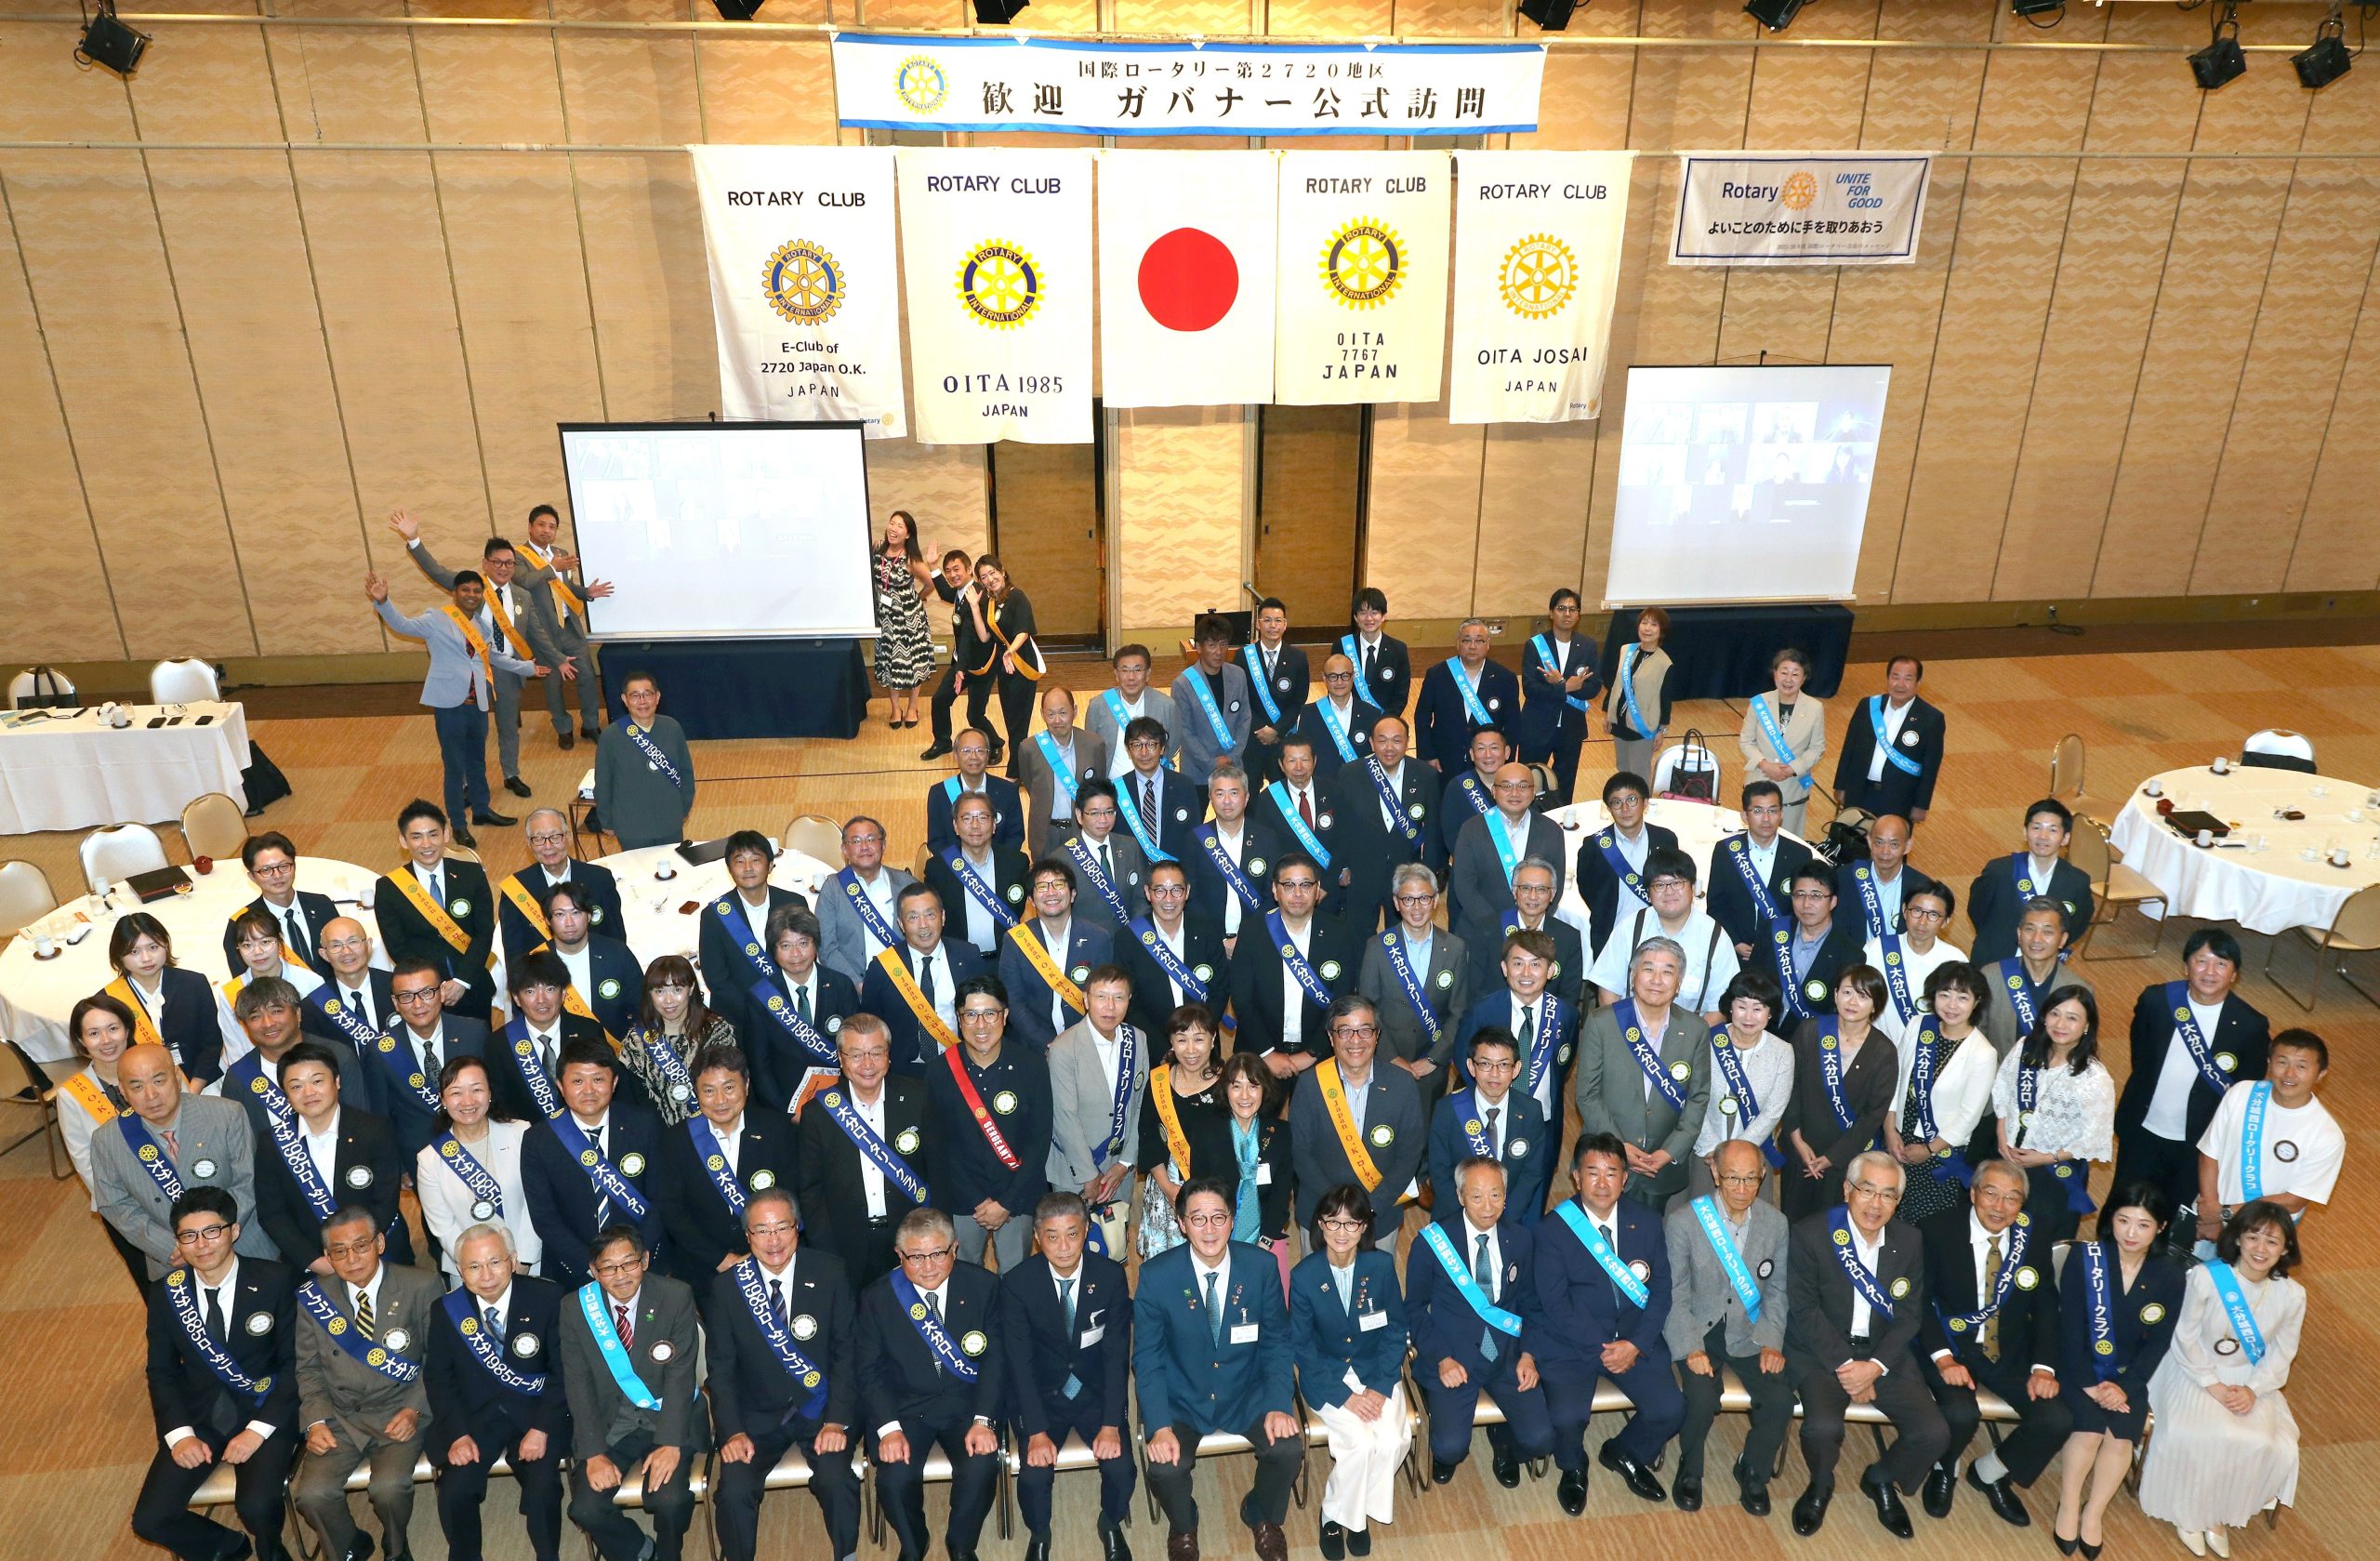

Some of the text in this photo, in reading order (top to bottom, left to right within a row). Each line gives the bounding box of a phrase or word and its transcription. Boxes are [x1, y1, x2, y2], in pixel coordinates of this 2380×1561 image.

[982, 82, 1486, 120] 歓迎 ガバナー公式訪問
[928, 176, 1062, 194] ROTARY CLUB
[1306, 177, 1427, 193] ROTARY CLUB
[1836, 173, 1871, 184] UNITE
[1480, 184, 1607, 200] ROTARY CLUB
[1722, 182, 1779, 202] Rotary
[1846, 185, 1871, 196] FOR
[728, 191, 866, 207] ROTARY CLUB
[1848, 198, 1884, 208] GOOD
[1344, 227, 1385, 242] ROTARY
[1707, 219, 1884, 234] よいことのために手を取りあおう
[785, 248, 820, 261] ROTARY
[977, 247, 1021, 262] ROTARY
[1523, 242, 1558, 254] ROTARY
[1331, 274, 1396, 300] INTERNATIONAL
[777, 296, 835, 317] INTERNATIONAL
[1508, 288, 1567, 312] INTERNATIONAL
[968, 297, 1034, 322] INTERNATIONAL
[1337, 332, 1384, 346] OITA
[782, 341, 839, 354] E-Club of
[1342, 349, 1378, 362] 7767
[1477, 346, 1588, 365] OITA JOSAI
[760, 361, 866, 375] 2720 Japan O.K.
[1322, 364, 1397, 379] JAPAN
[787, 382, 840, 398] JAPAN
[943, 374, 1064, 394] OITA 1985
[1504, 379, 1558, 393] JAPAN
[982, 403, 1028, 417] JAPAN
[1569, 402, 1588, 411] Rotary
[1860, 880, 1882, 939] 大分ロータリ
[1115, 1026, 1134, 1135] 大分ロータリークラブ
[983, 1121, 1012, 1162] SERGEANT
[837, 1106, 918, 1195] 大分ロータリークラブ
[736, 1259, 813, 1375] 大分1985ロータリークラブ
